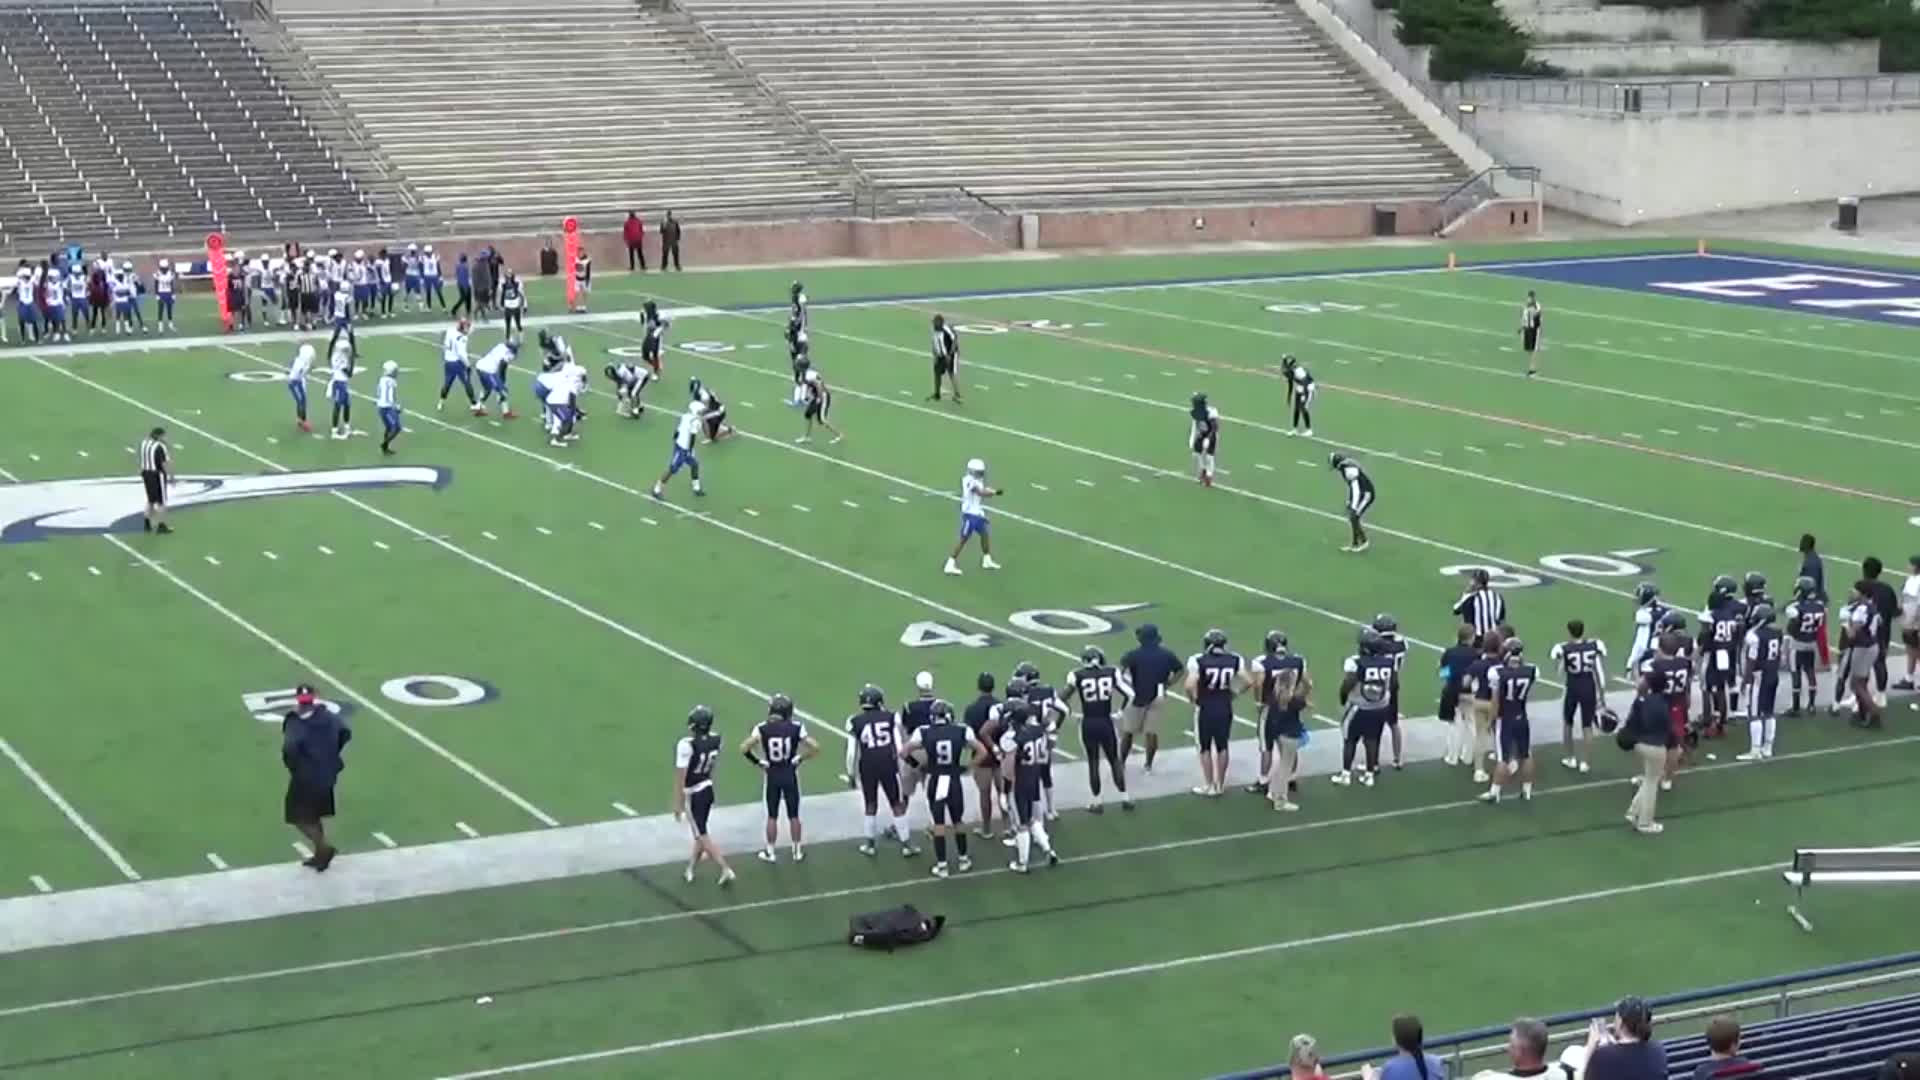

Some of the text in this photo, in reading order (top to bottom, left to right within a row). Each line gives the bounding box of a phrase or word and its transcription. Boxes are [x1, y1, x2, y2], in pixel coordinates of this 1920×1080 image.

[1440, 553, 1642, 587] 30
[900, 609, 1113, 648] 40
[1567, 650, 1595, 674] 35
[1081, 677, 1113, 701] 28
[1205, 667, 1234, 690] 70
[1506, 677, 1530, 701] 17
[241, 674, 486, 722] 50
[860, 722, 891, 748] 45
[768, 736, 792, 762] 81
[935, 740, 953, 765] 9
